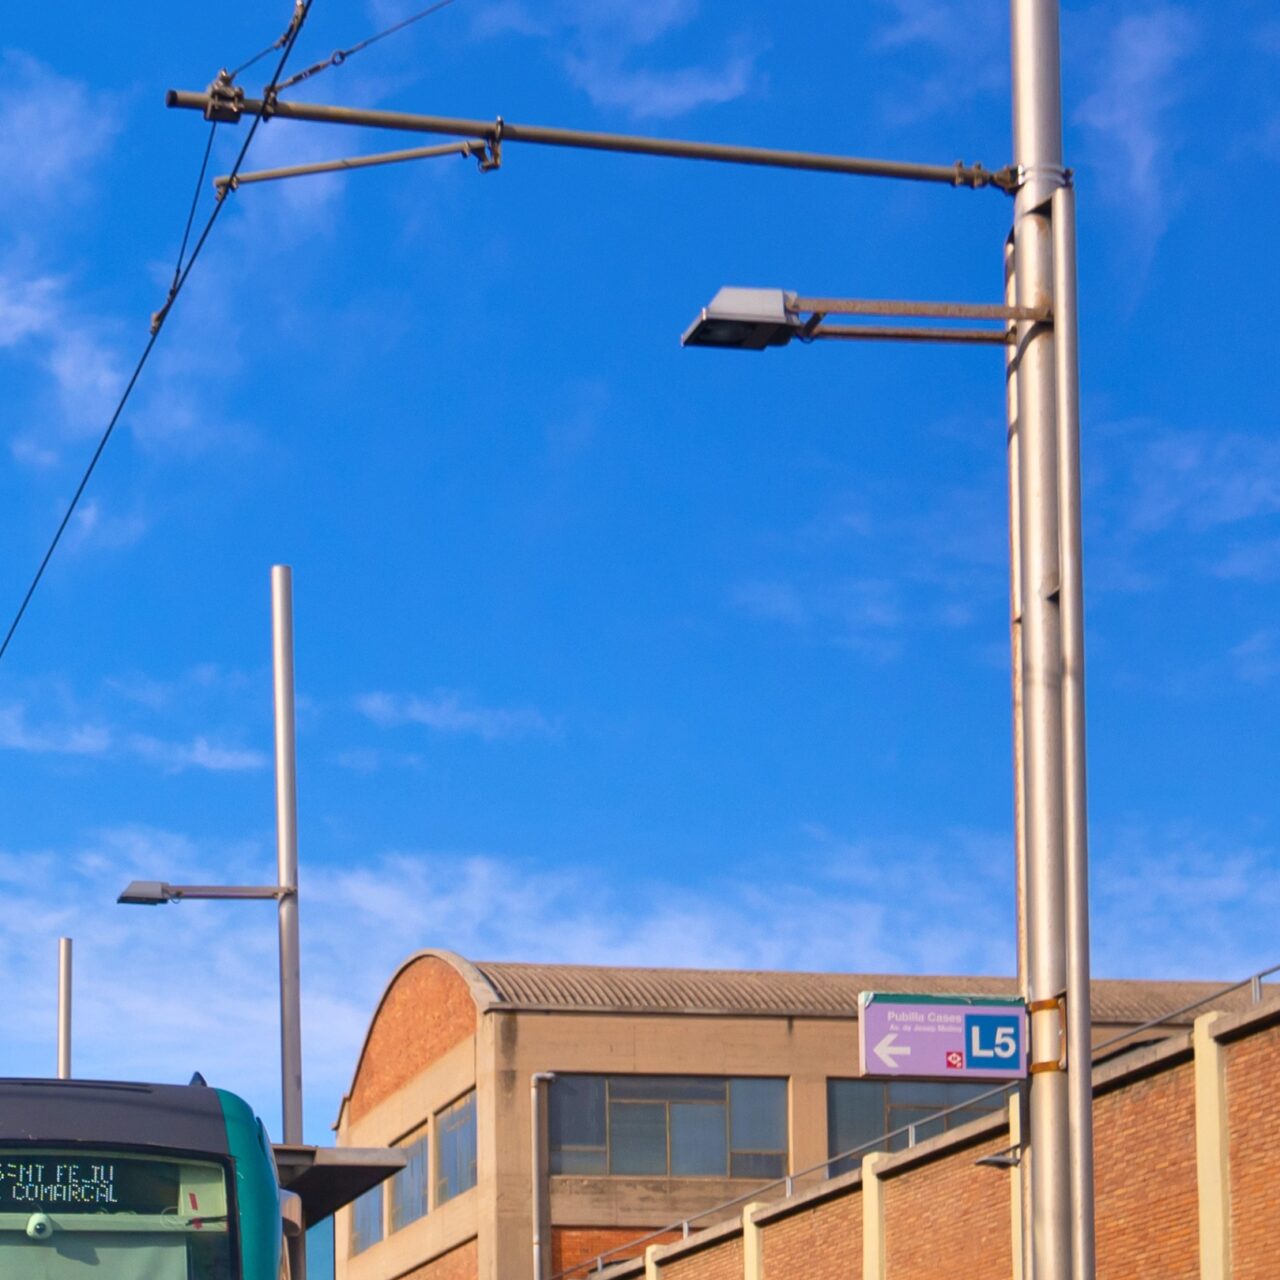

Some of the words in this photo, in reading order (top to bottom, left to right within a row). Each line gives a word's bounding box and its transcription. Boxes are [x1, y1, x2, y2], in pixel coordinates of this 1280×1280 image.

[927, 1012, 962, 1024] Cases
[971, 1025, 1016, 1058] L5
[12, 1182, 118, 1202] COMARCAL
